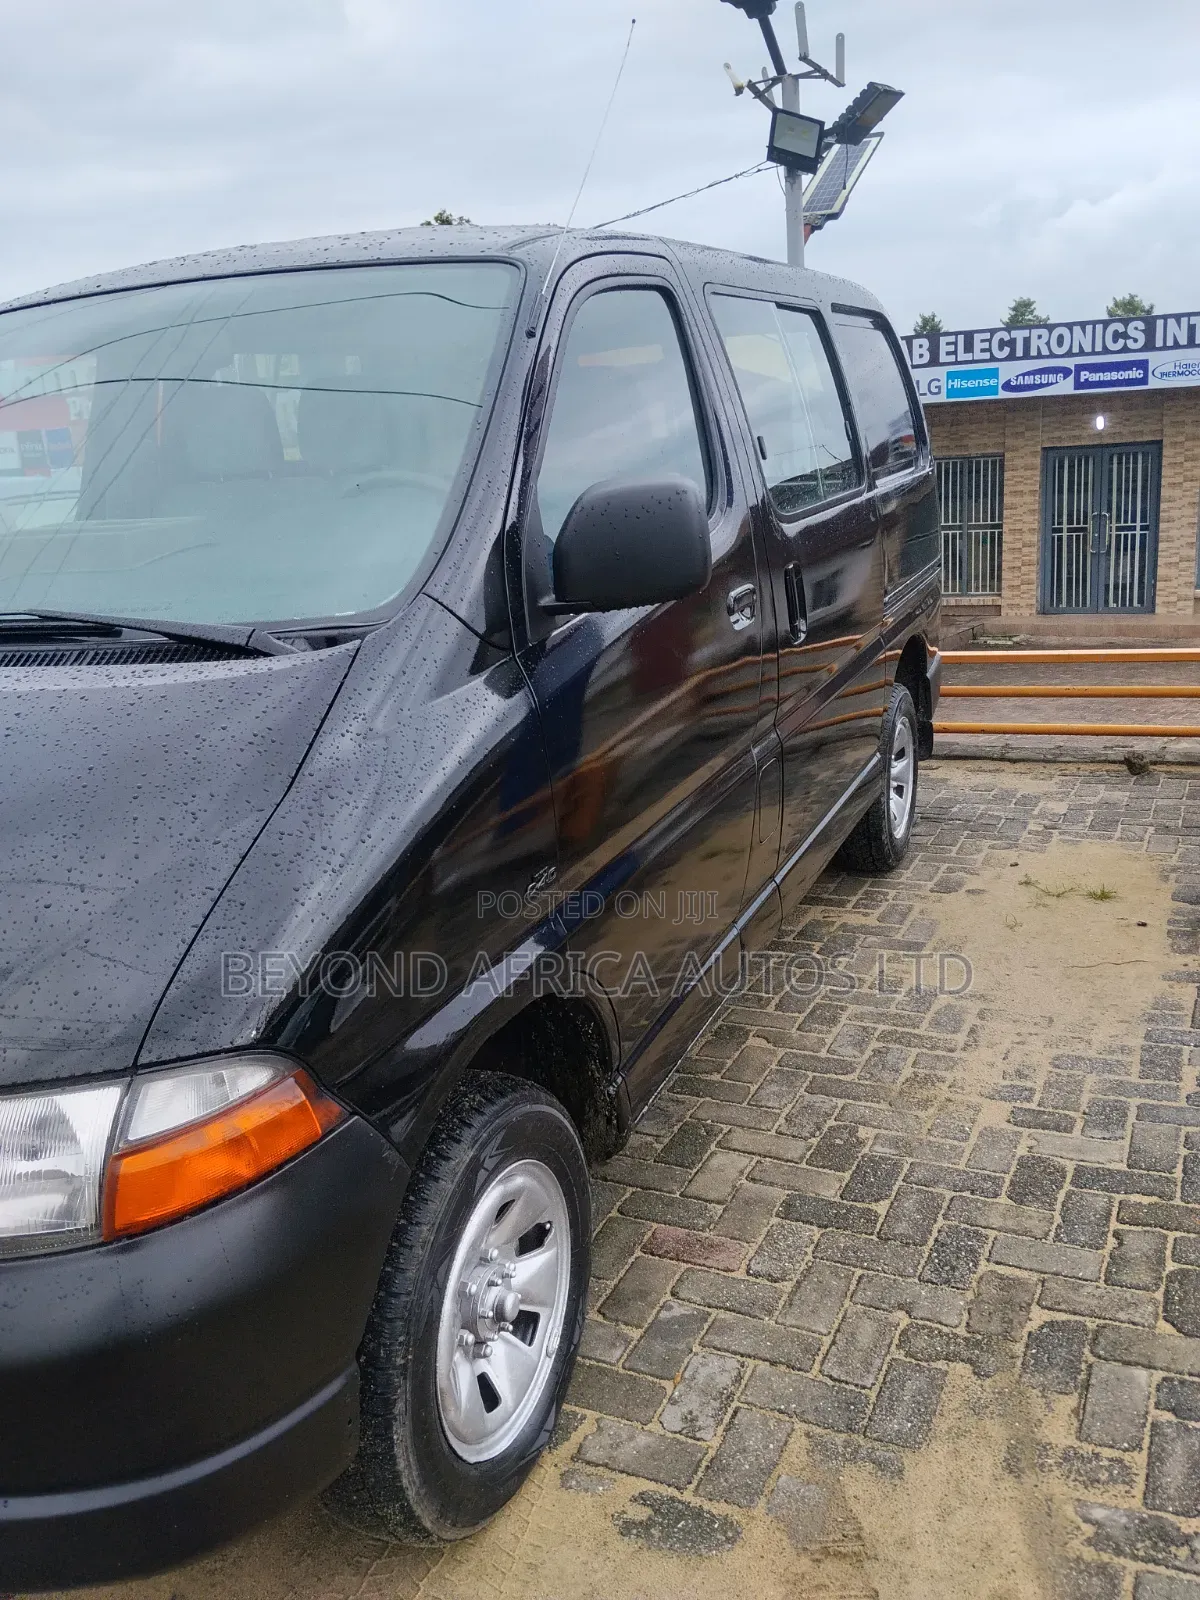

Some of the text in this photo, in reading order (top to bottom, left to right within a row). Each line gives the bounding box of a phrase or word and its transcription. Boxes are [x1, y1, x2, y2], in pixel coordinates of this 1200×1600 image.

[939, 320, 1145, 363] ELECTRONICS
[1010, 373, 1064, 386] SAMSUNG
[1080, 368, 1144, 382] Panasonic
[916, 378, 942, 396] LG
[948, 378, 998, 389] Hisense
